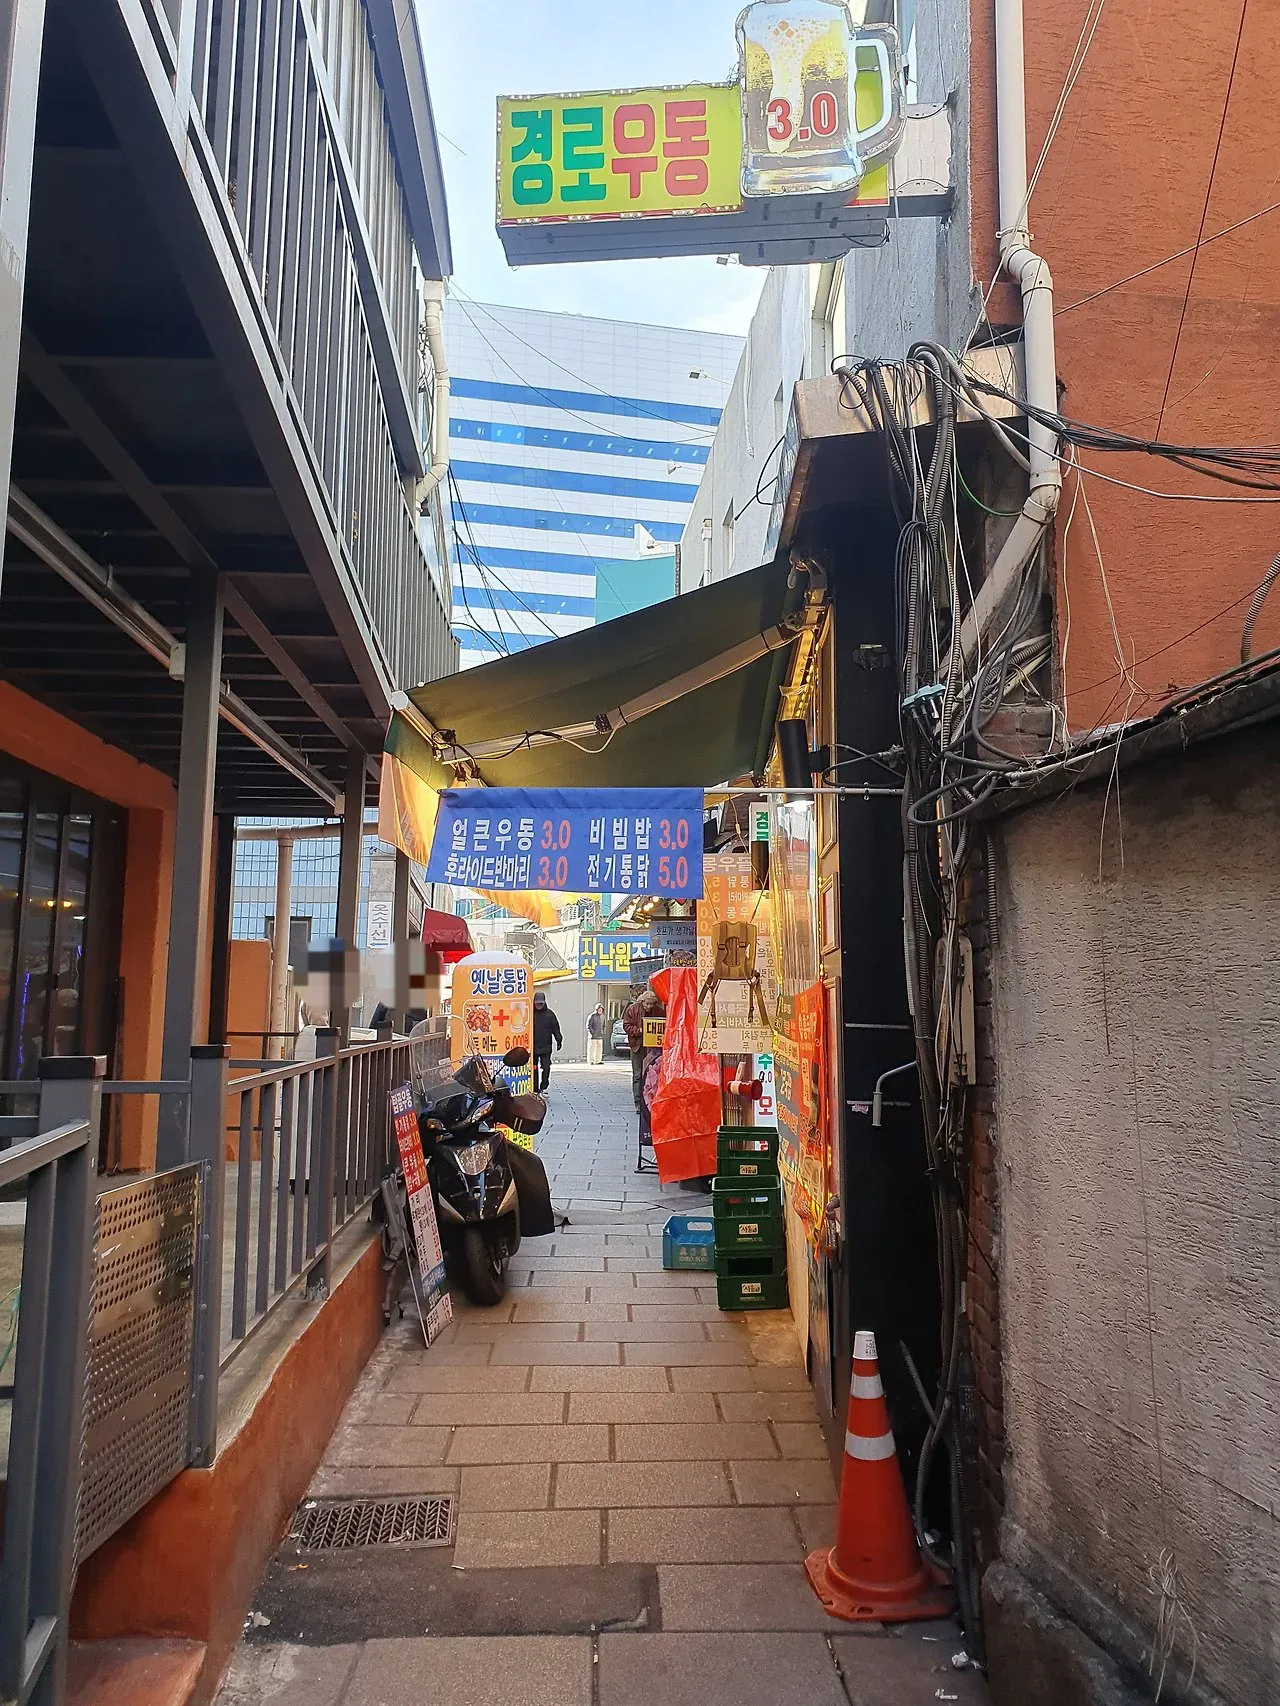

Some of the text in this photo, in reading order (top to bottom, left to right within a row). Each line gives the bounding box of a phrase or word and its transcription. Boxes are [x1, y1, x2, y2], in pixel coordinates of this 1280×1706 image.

[766, 92, 839, 142] 3.0
[511, 99, 711, 206] 경로우동
[452, 817, 689, 852] 얼큰우동 3.0 비빔밥 3.0
[444, 852, 689, 889] 후라이드반마리 3.0 전기통닭 5.0
[371, 904, 389, 941] 옷수선
[581, 937, 598, 979] 지상
[599, 942, 631, 972] 낙원
[470, 968, 529, 996] 옛날통닭
